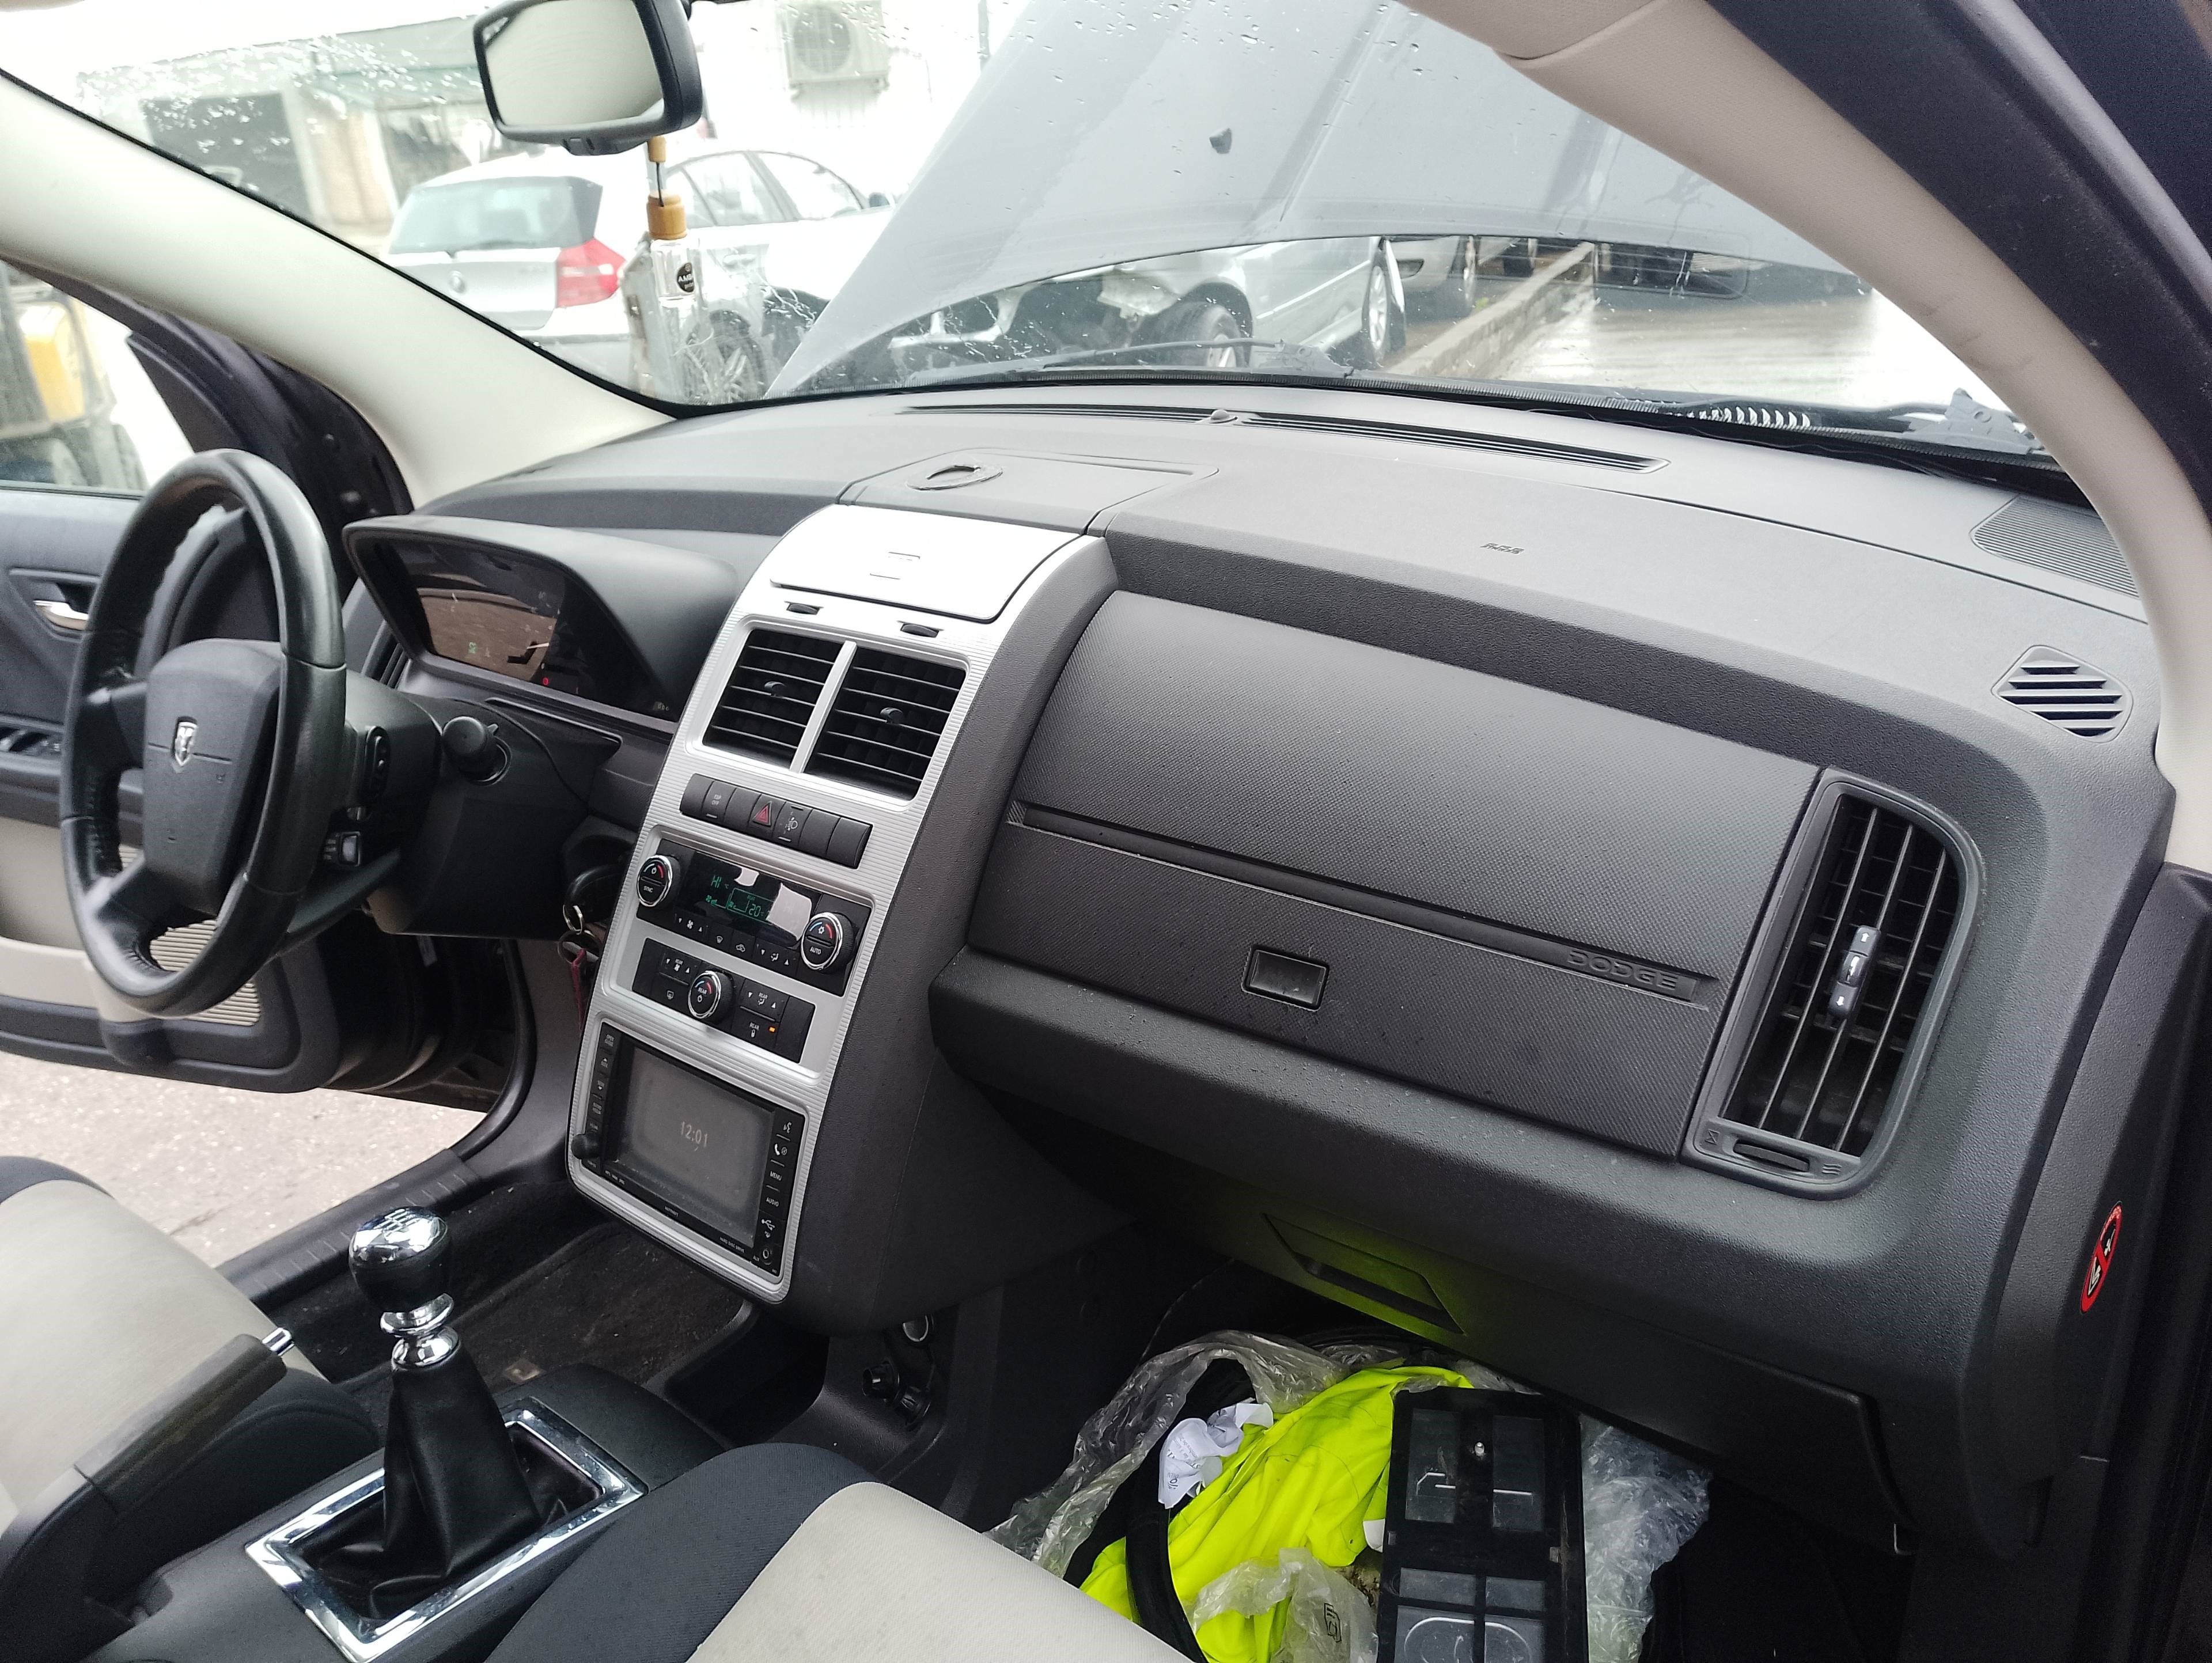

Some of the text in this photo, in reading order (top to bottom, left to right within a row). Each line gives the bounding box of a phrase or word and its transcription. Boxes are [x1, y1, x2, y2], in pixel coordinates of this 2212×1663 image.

[749, 903, 761, 917] 20
[810, 946, 821, 955] AUTO
[1567, 950, 1678, 991] DODGE
[681, 1121, 708, 1147] 12:01
[770, 1170, 782, 1181] MENU
[766, 1197, 779, 1207] AUDIO
